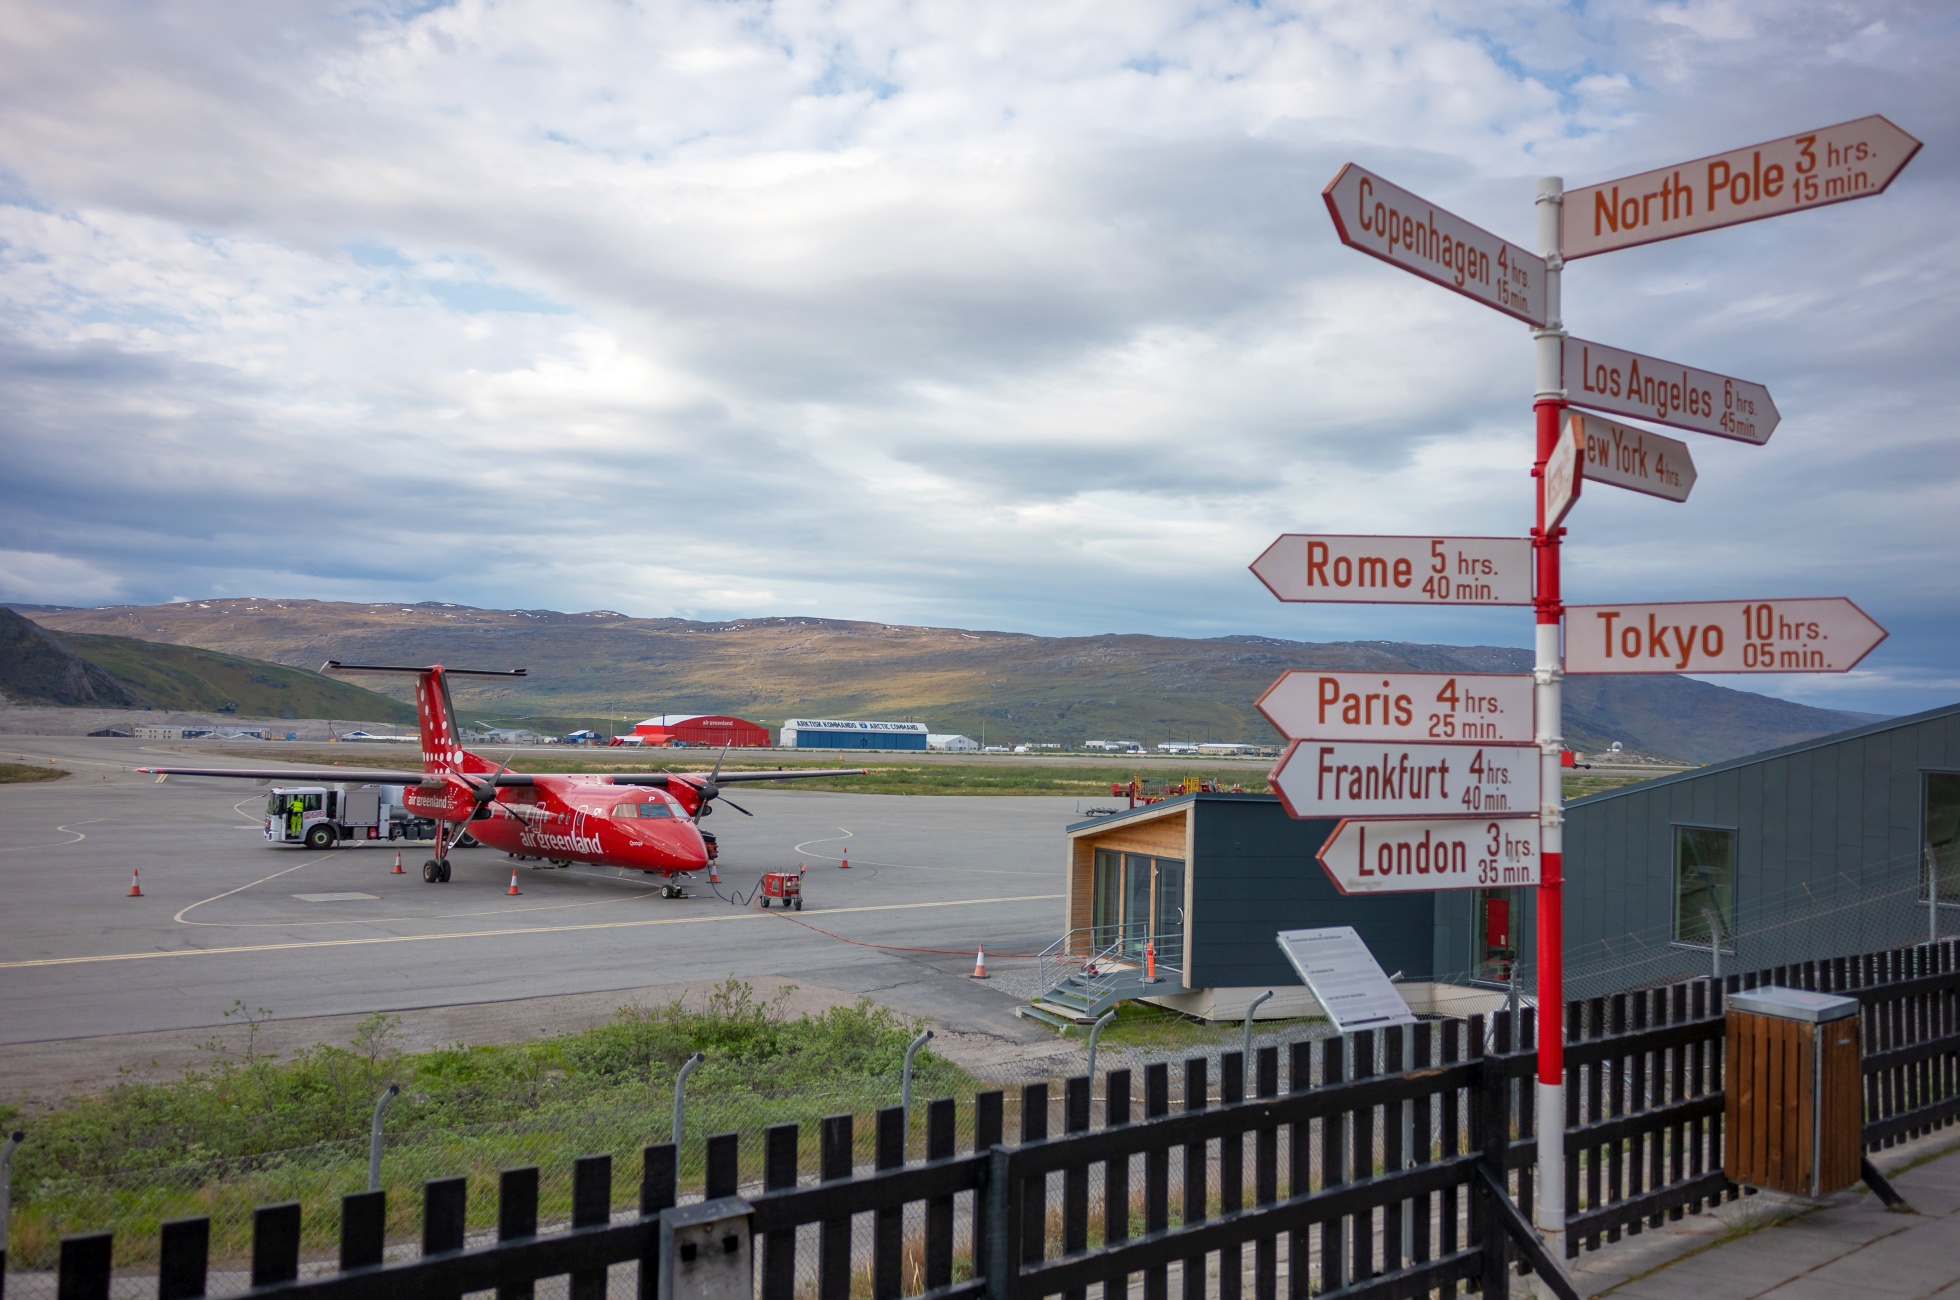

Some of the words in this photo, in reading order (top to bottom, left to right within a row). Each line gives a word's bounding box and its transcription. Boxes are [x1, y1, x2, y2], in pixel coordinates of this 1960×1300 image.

[1594, 171, 1694, 236] North
[1707, 151, 1784, 212] Pole
[1795, 135, 1817, 174] 3
[1827, 141, 1877, 168] hrs.
[1793, 174, 1819, 204] 15
[1825, 168, 1876, 198] min.
[1359, 176, 1490, 288] Copenhagen
[1497, 244, 1508, 277] 4
[1512, 257, 1530, 289] hrs.
[1496, 277, 1510, 305] 15
[1511, 290, 1530, 314] min.
[1583, 346, 1621, 397] Los
[1627, 358, 1712, 419] Angeles
[1724, 379, 1733, 409] 6
[1736, 391, 1757, 416] hrs.
[1719, 411, 1735, 433] 45
[1736, 418, 1759, 438] min.
[1587, 434, 1610, 468] ew
[1612, 427, 1648, 478] York
[1655, 452, 1664, 483] 4
[1664, 463, 1682, 487] hrs.
[1307, 541, 1413, 588] Rome
[1431, 540, 1446, 574] 5
[1458, 551, 1499, 575] hrs.
[1422, 575, 1450, 599] 40
[1456, 577, 1499, 600] min.
[1597, 611, 1723, 669] Tokyo
[1742, 604, 1773, 641] 10
[1779, 614, 1828, 640] hrs.
[1743, 642, 1775, 668] 05
[1780, 643, 1832, 669] min.
[1318, 677, 1413, 726] Paris
[1436, 678, 1460, 712] 4
[1465, 688, 1504, 713] hrs.
[822, 721, 857, 729] KOMMANDO
[1428, 713, 1456, 738] 25
[1462, 715, 1504, 739] min.
[1317, 747, 1449, 800] Frankfurt
[1469, 749, 1484, 784] 4
[1487, 759, 1512, 785] hrs.
[408, 792, 416, 805] air
[416, 795, 447, 809] greenland
[1461, 786, 1481, 811] 40
[1484, 787, 1512, 810] min.
[520, 826, 537, 847] air
[537, 830, 604, 855] greenland
[1359, 826, 1466, 876] London
[1486, 822, 1500, 857] 3
[1506, 832, 1535, 856] hrs.
[1478, 859, 1498, 884] 35
[1503, 859, 1535, 883] min.
